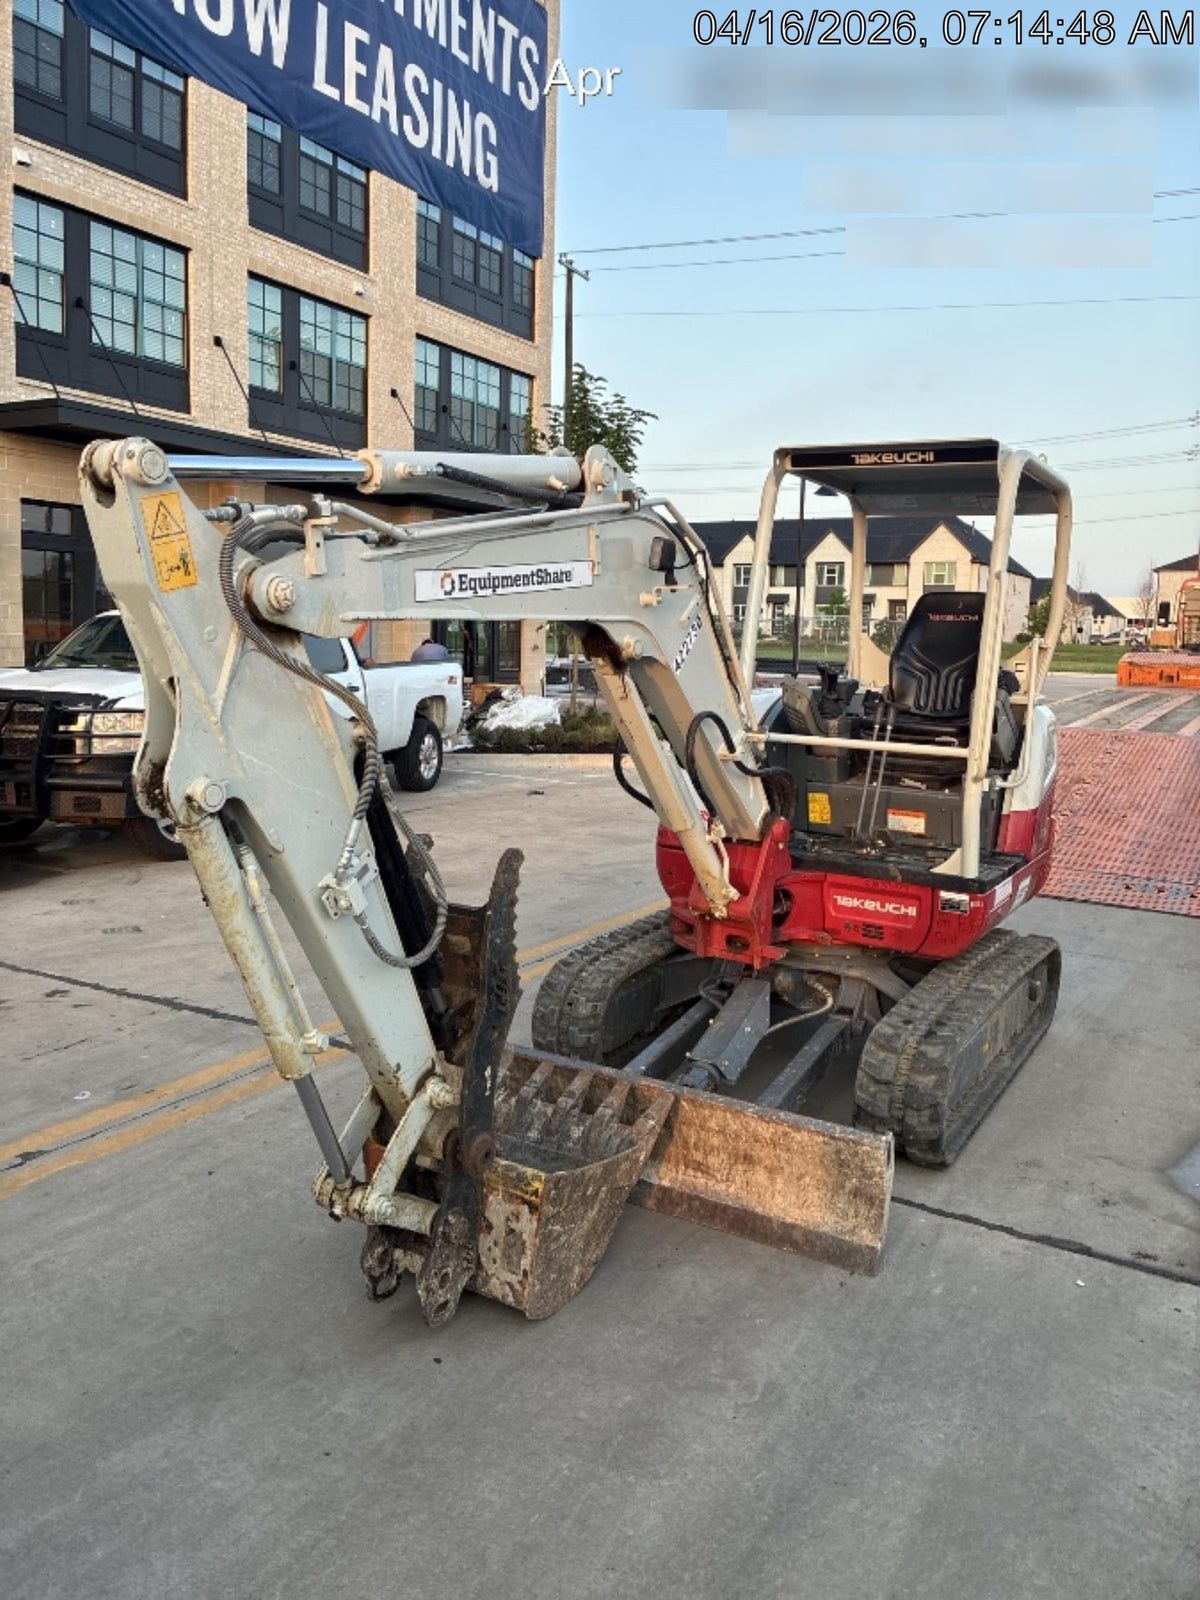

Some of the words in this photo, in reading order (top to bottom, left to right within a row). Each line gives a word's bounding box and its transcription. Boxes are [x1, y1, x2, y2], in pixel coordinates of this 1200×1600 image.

[313, 1, 499, 193] LEASING
[850, 451, 935, 465] TAKEUCHI
[457, 568, 573, 594] EquipmentShare
[833, 895, 917, 917] TAKEUCHI
